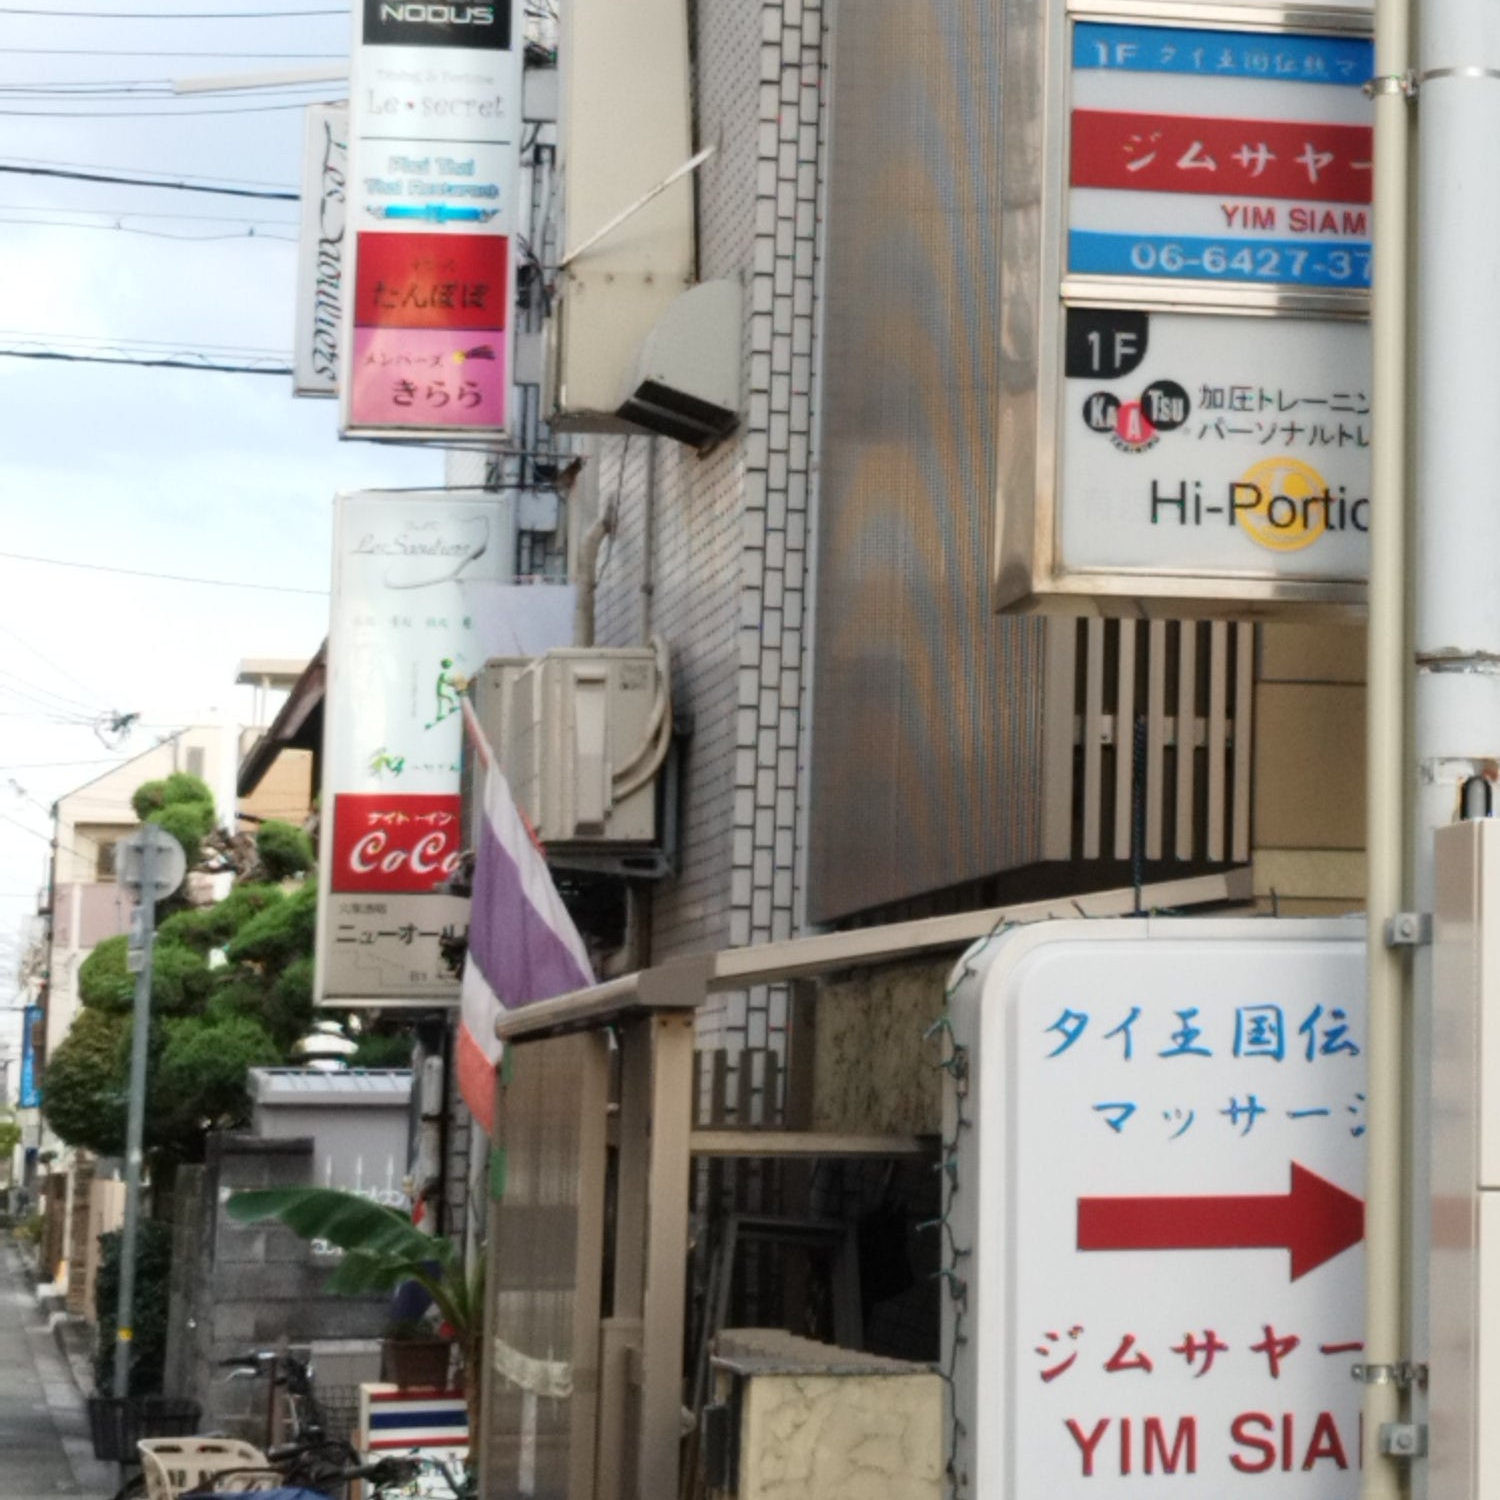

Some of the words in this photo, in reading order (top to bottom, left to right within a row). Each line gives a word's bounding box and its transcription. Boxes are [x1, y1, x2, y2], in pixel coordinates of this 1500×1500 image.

[1220, 204, 1276, 230] YIM
[1288, 208, 1368, 235] SIAM
[1086, 329, 1138, 372] 1F
[392, 379, 483, 408] きらら
[1034, 1324, 1364, 1382] ジムサヤー
[1065, 1416, 1198, 1477] YIM
[1228, 1411, 1364, 1476] SIA
